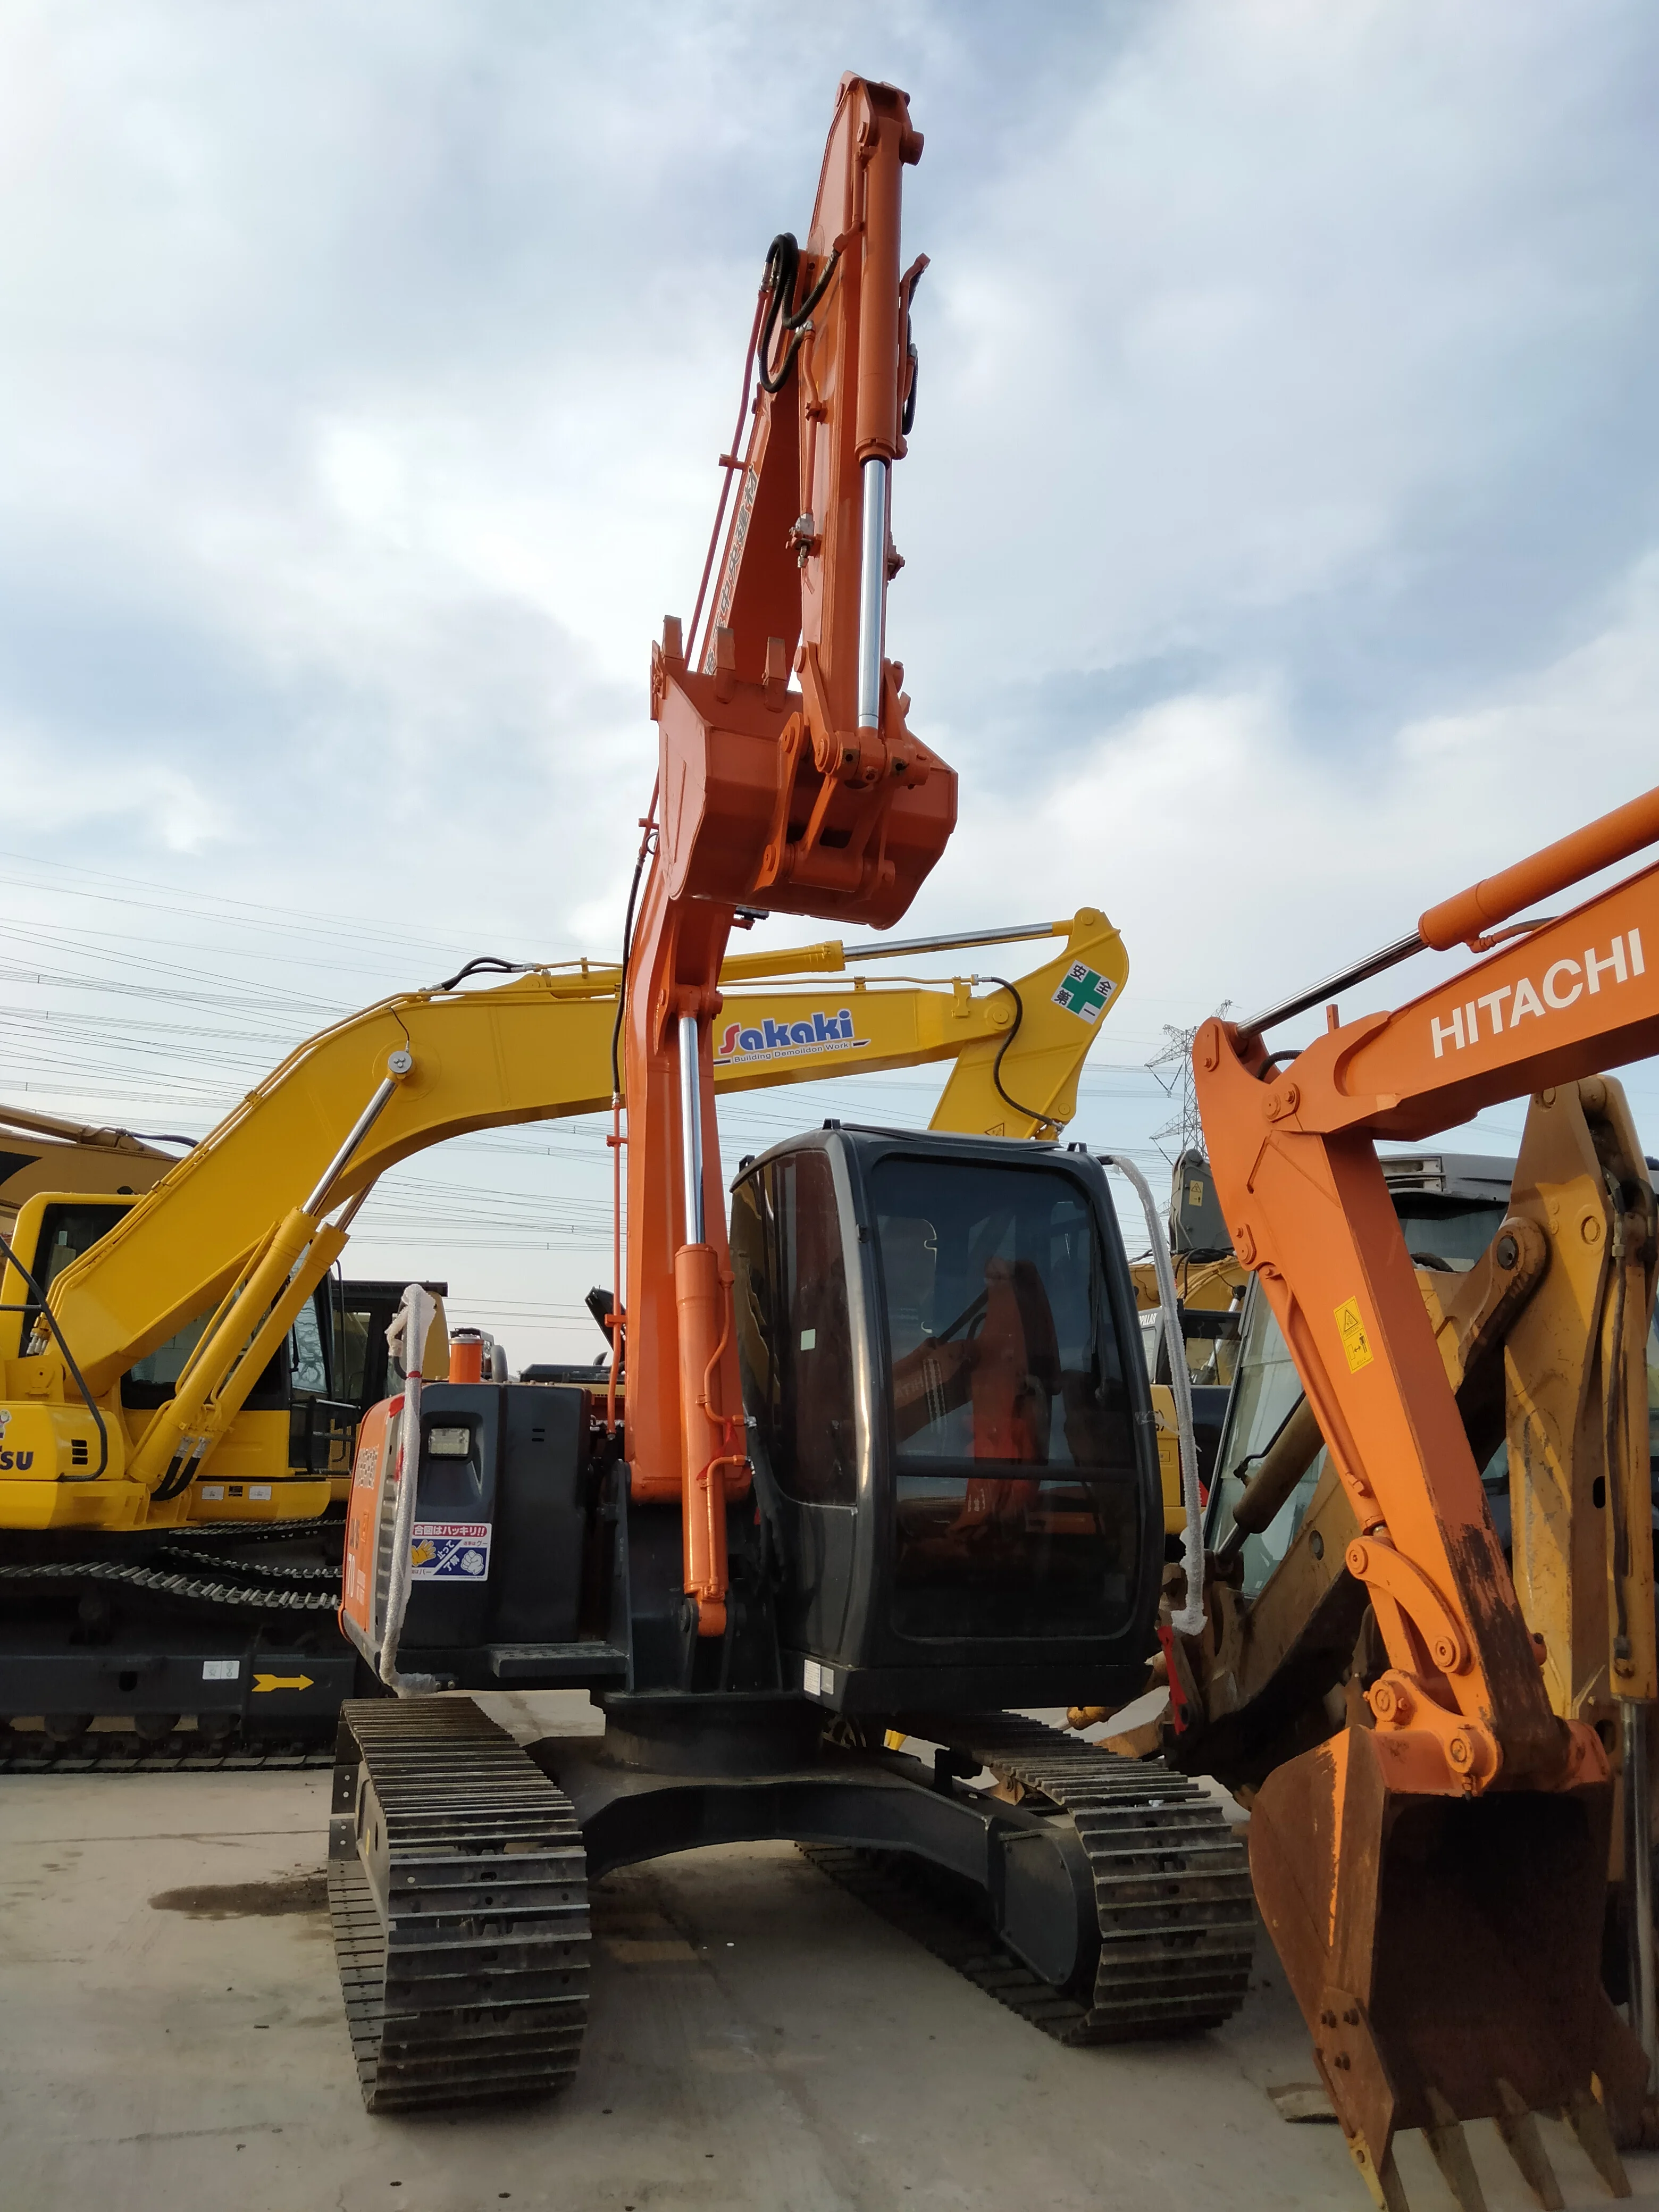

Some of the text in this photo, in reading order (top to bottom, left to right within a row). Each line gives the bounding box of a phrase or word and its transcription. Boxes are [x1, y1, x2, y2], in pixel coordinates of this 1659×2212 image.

[1430, 927, 1645, 1059] HITACHI
[719, 1009, 853, 1054] Sakaki
[734, 1052, 772, 1063] Building
[825, 1042, 849, 1051] Work
